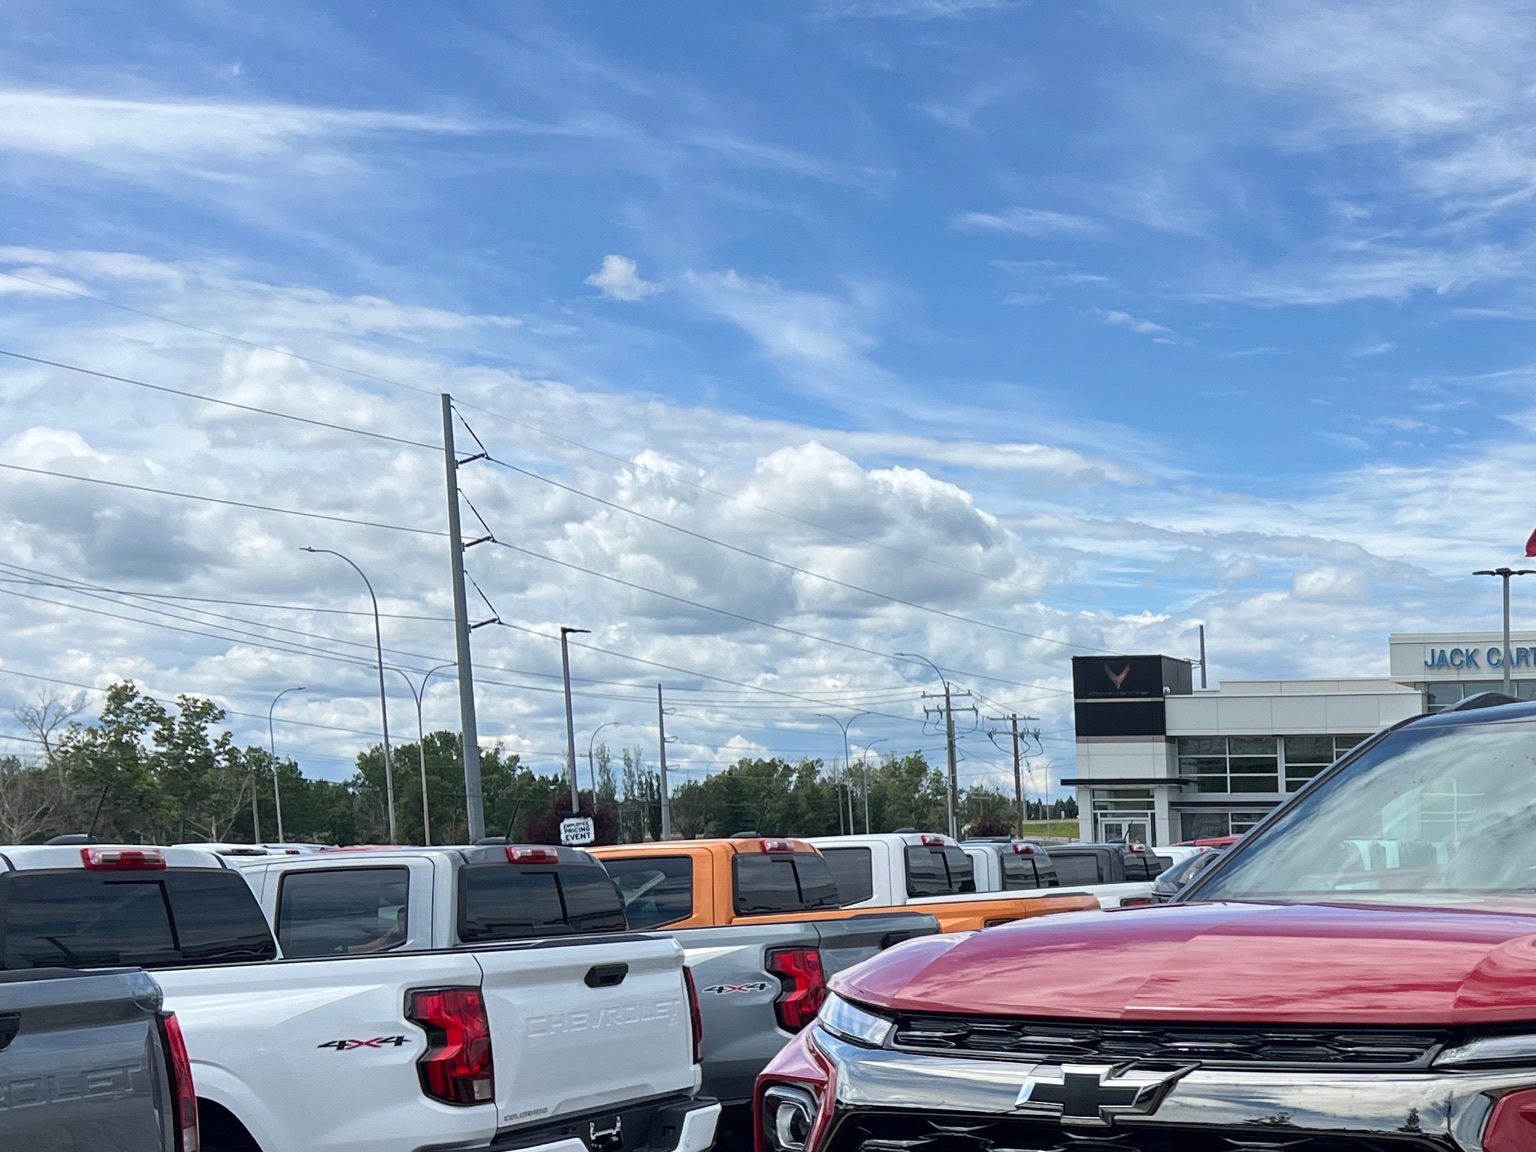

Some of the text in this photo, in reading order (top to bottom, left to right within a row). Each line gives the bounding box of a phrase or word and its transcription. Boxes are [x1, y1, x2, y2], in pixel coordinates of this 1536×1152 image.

[1424, 648, 1480, 668] JACK
[565, 832, 591, 841] EVENT
[525, 999, 682, 1038] CHEVROLET
[0, 1063, 142, 1112] OLET
